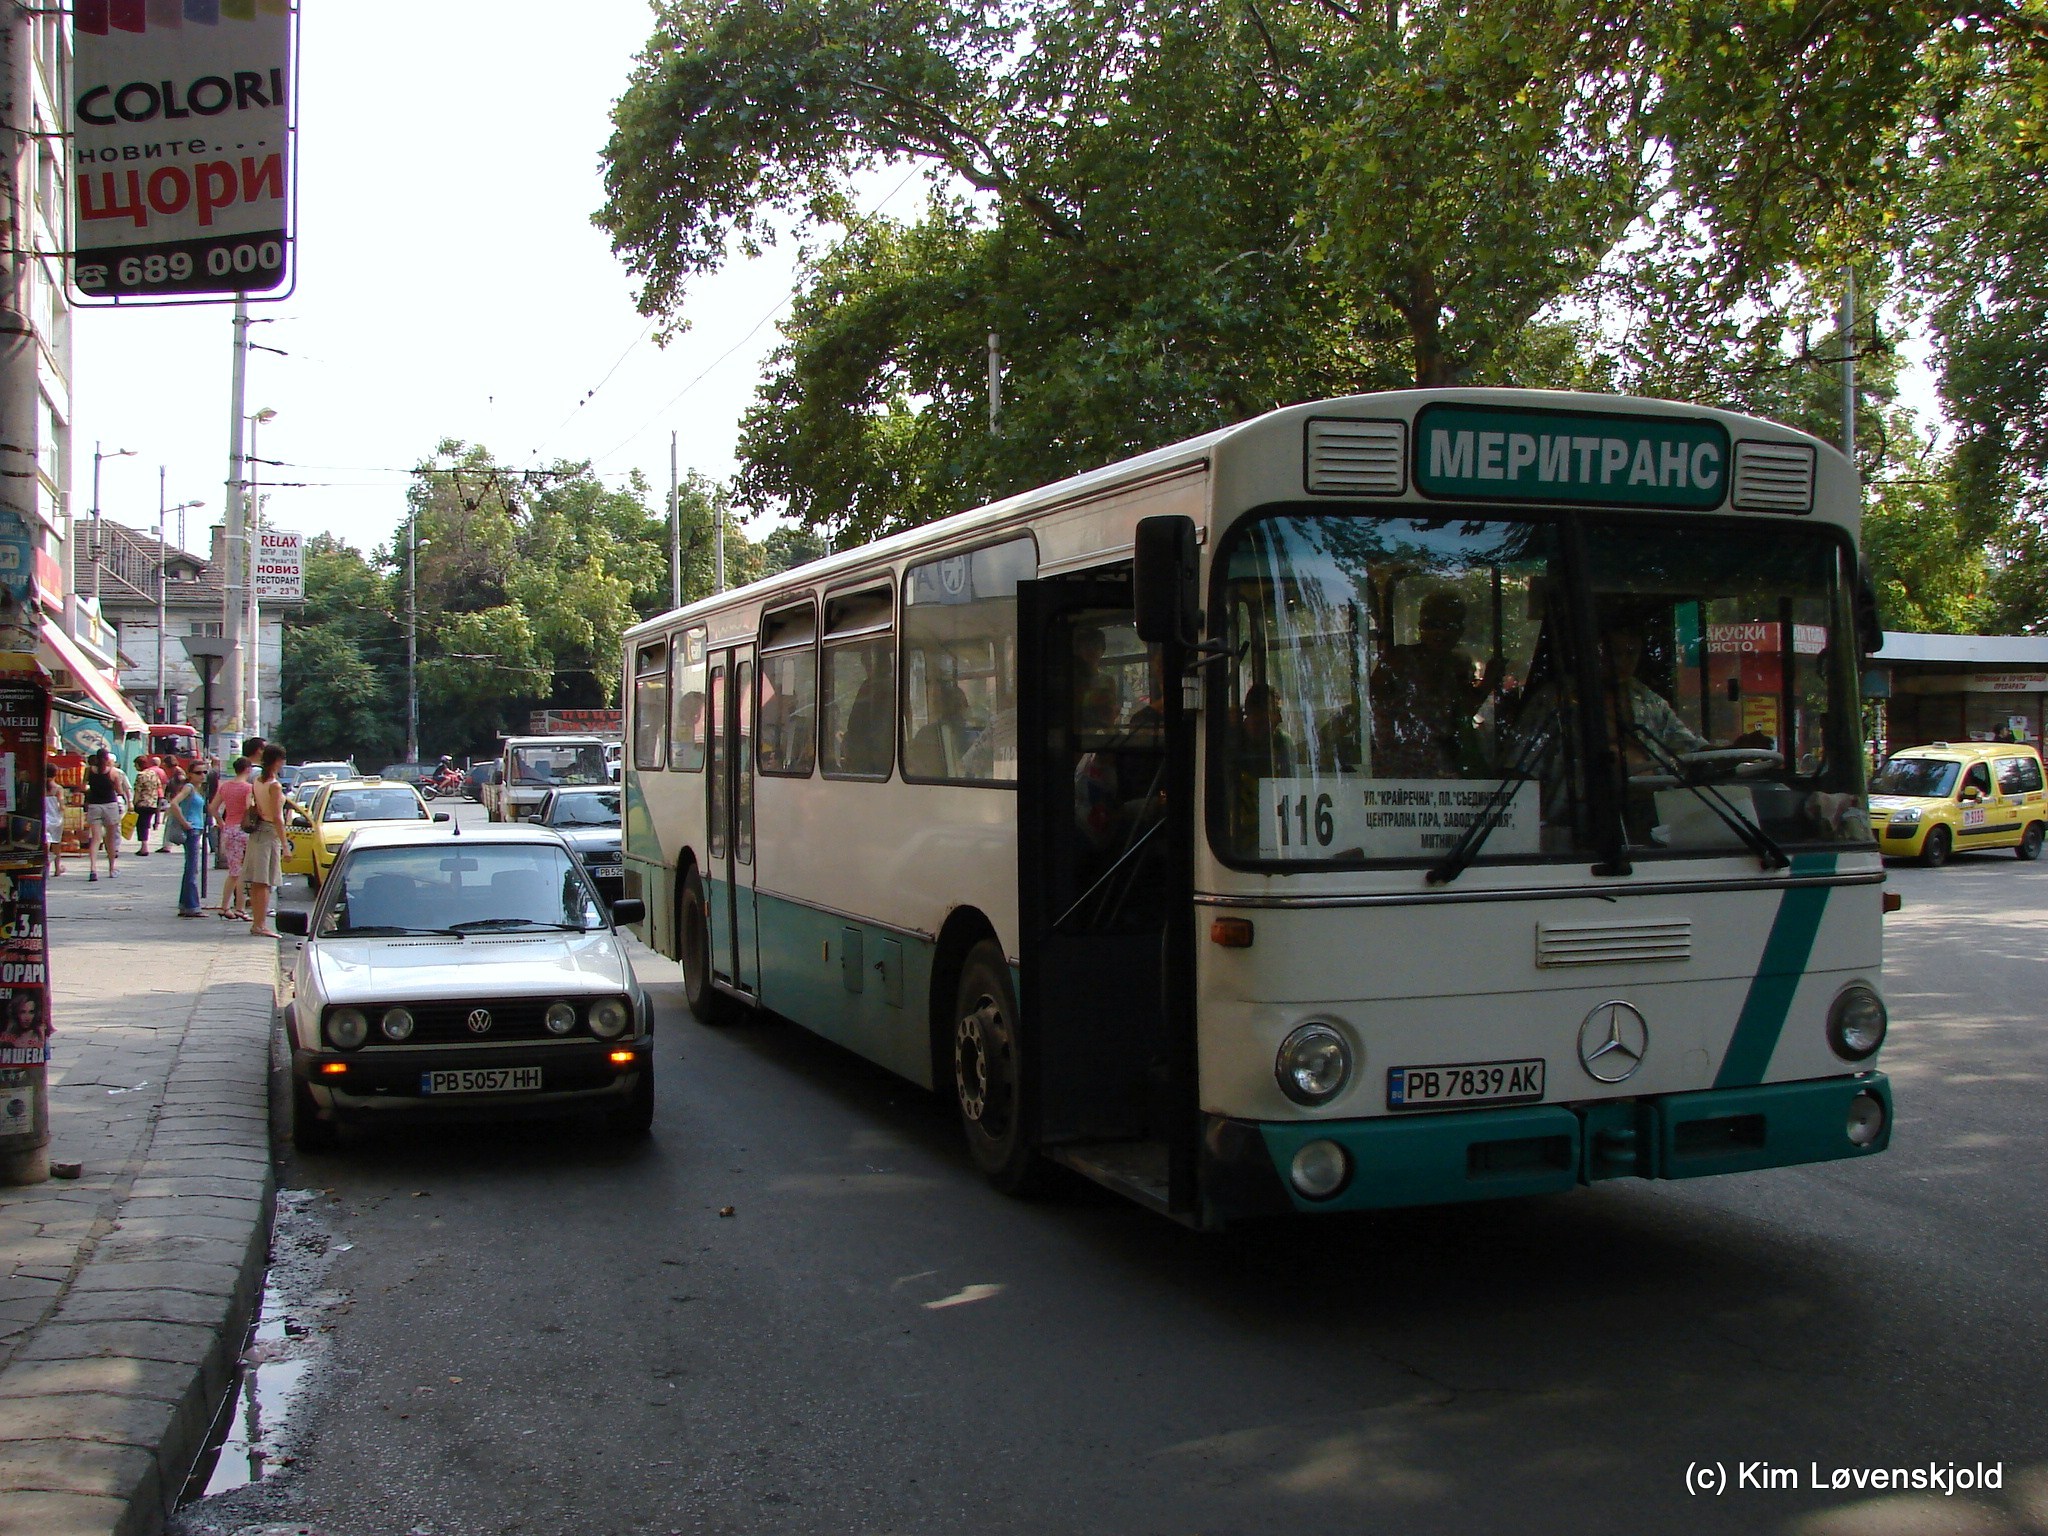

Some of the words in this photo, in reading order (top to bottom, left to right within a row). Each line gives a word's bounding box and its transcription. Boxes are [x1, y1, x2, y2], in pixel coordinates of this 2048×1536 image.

[76, 67, 285, 126] COLORI
[118, 252, 194, 286] 689
[207, 241, 283, 277] 000
[1429, 429, 1720, 490] МЕРИТРАНС
[261, 535, 297, 548] RELAX
[256, 575, 300, 585] РЕСТОРАНТ
[257, 565, 299, 575] НОВИЗ
[1277, 793, 1335, 847] 116
[1366, 812, 1416, 829] ЦЕНТРАЛНА
[434, 1073, 459, 1091] PB
[463, 1071, 509, 1090] 5057
[513, 1069, 538, 1088] HH
[1407, 1072, 1440, 1099] PB
[1446, 1068, 1504, 1097] 7839
[1508, 1065, 1538, 1093] AK
